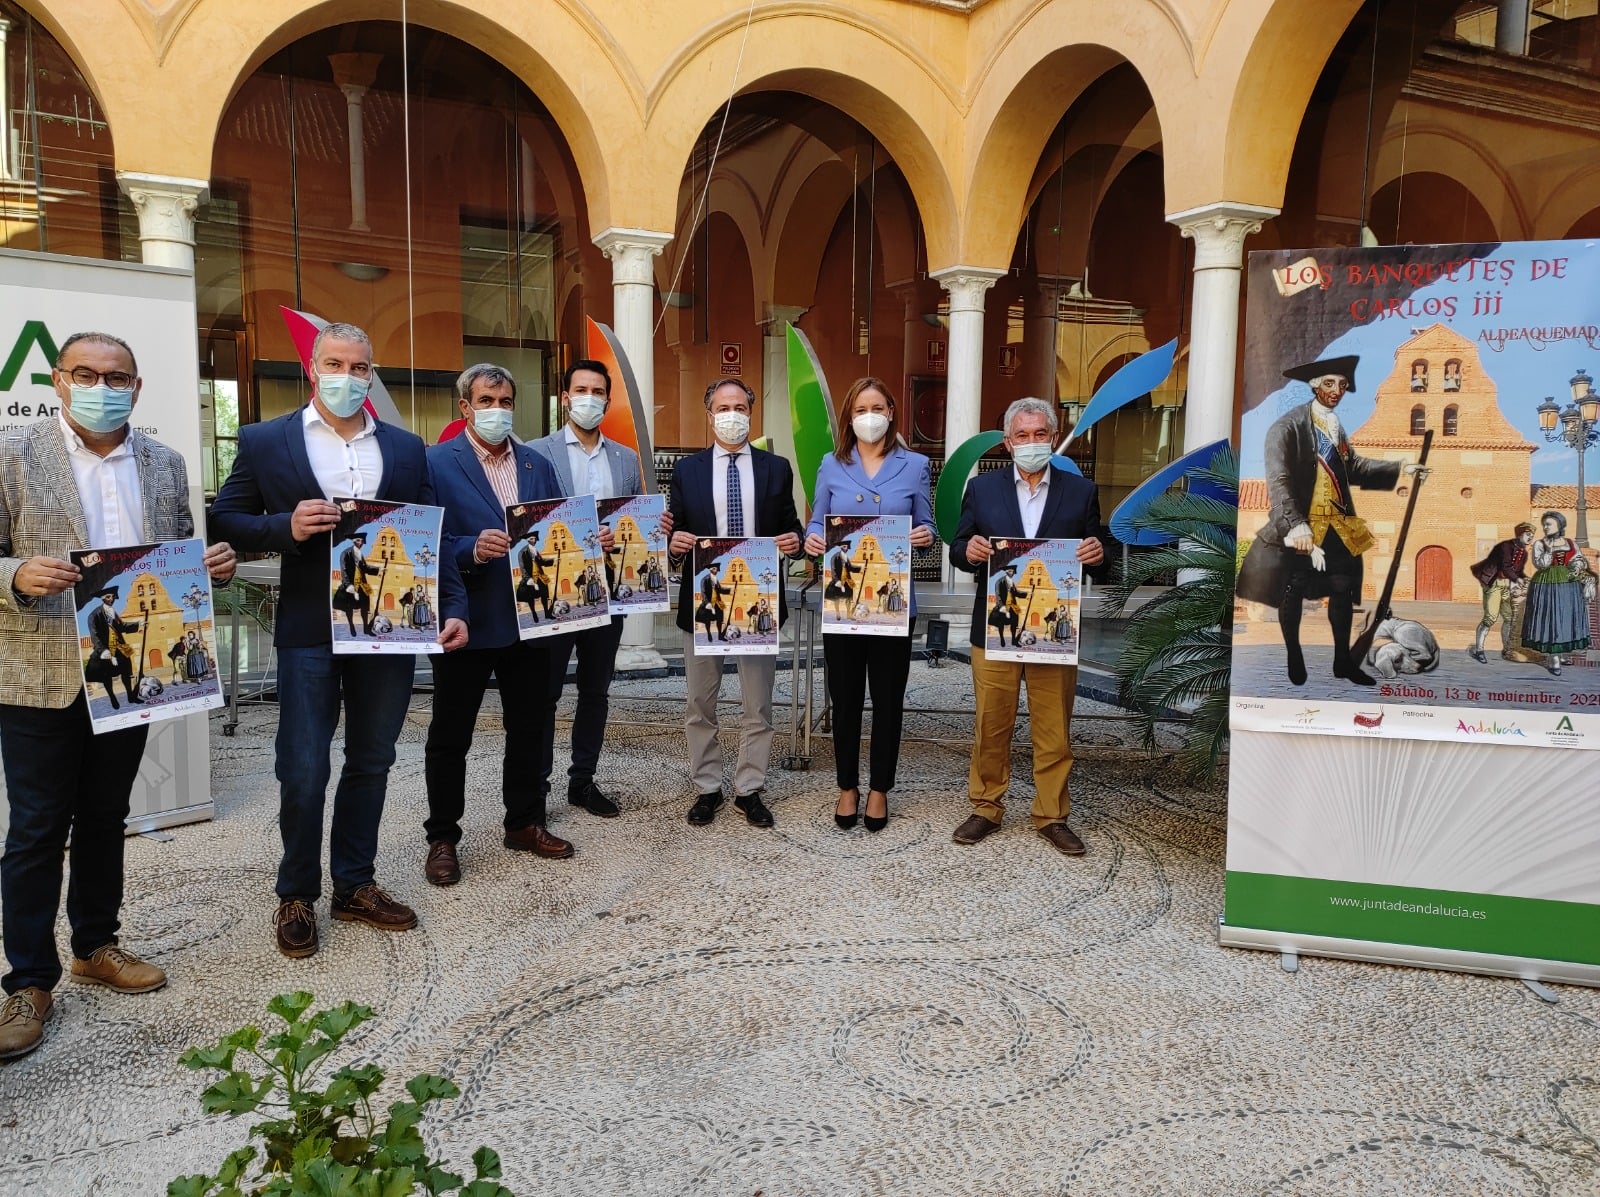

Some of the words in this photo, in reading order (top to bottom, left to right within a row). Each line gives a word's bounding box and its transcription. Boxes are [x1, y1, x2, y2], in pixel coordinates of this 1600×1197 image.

[1284, 265, 1334, 291] LOS
[1348, 257, 1515, 287] BANQUETES
[1530, 258, 1568, 281] DE
[1351, 296, 1458, 322] CARLOS
[1478, 325, 1600, 352] ALDEAQUEMAD
[7, 401, 31, 416] de
[1380, 683, 1438, 699] Sábado,
[1445, 687, 1459, 700] 13
[1467, 688, 1481, 701] de
[1488, 690, 1562, 705] noviembre
[1456, 719, 1528, 737] Andalucía
[1329, 895, 1487, 920] www.juntadeandalucia.es
